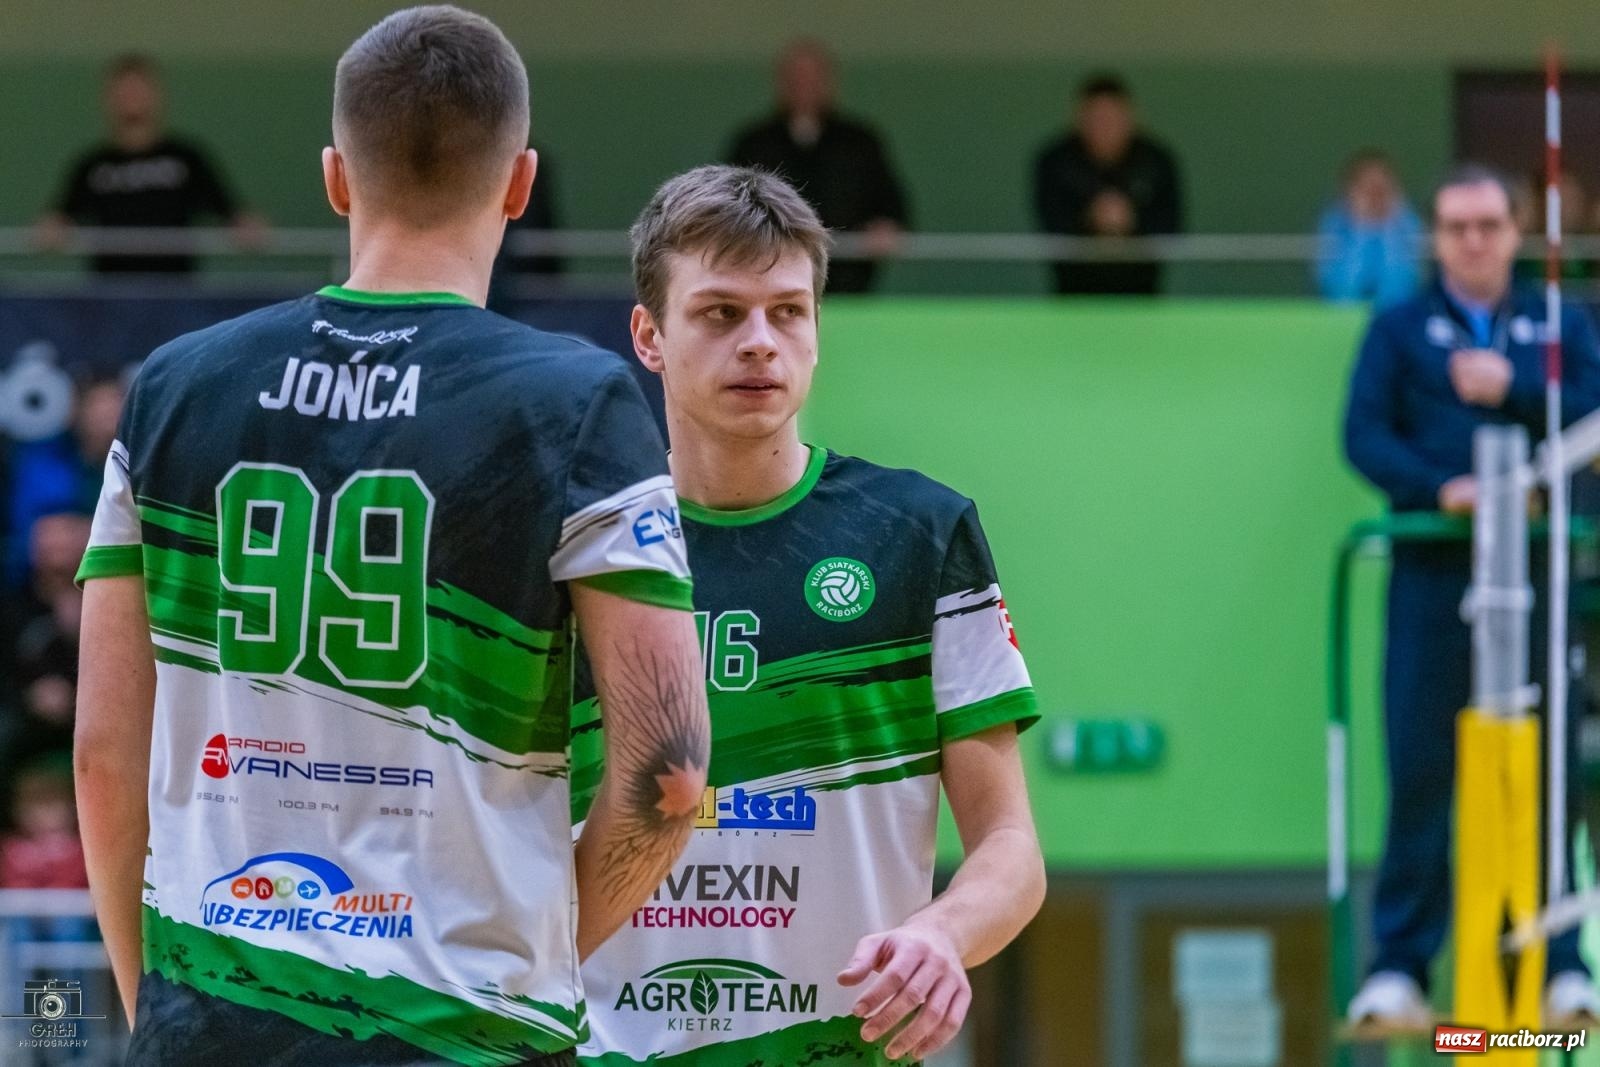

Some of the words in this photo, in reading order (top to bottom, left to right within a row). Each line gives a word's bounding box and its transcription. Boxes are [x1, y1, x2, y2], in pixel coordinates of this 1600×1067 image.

[258, 350, 421, 421] JOŃCA
[632, 507, 677, 547] EN
[215, 461, 436, 689] 99
[811, 566, 828, 587] KLUB
[827, 562, 871, 590] SIATKARSKI
[228, 738, 306, 754] RADIO
[229, 756, 434, 789] VANESSA
[333, 893, 413, 913] MULTI
[203, 902, 413, 938] UBEZPIECZENIA
[667, 1018, 733, 1031] KIETRZ
